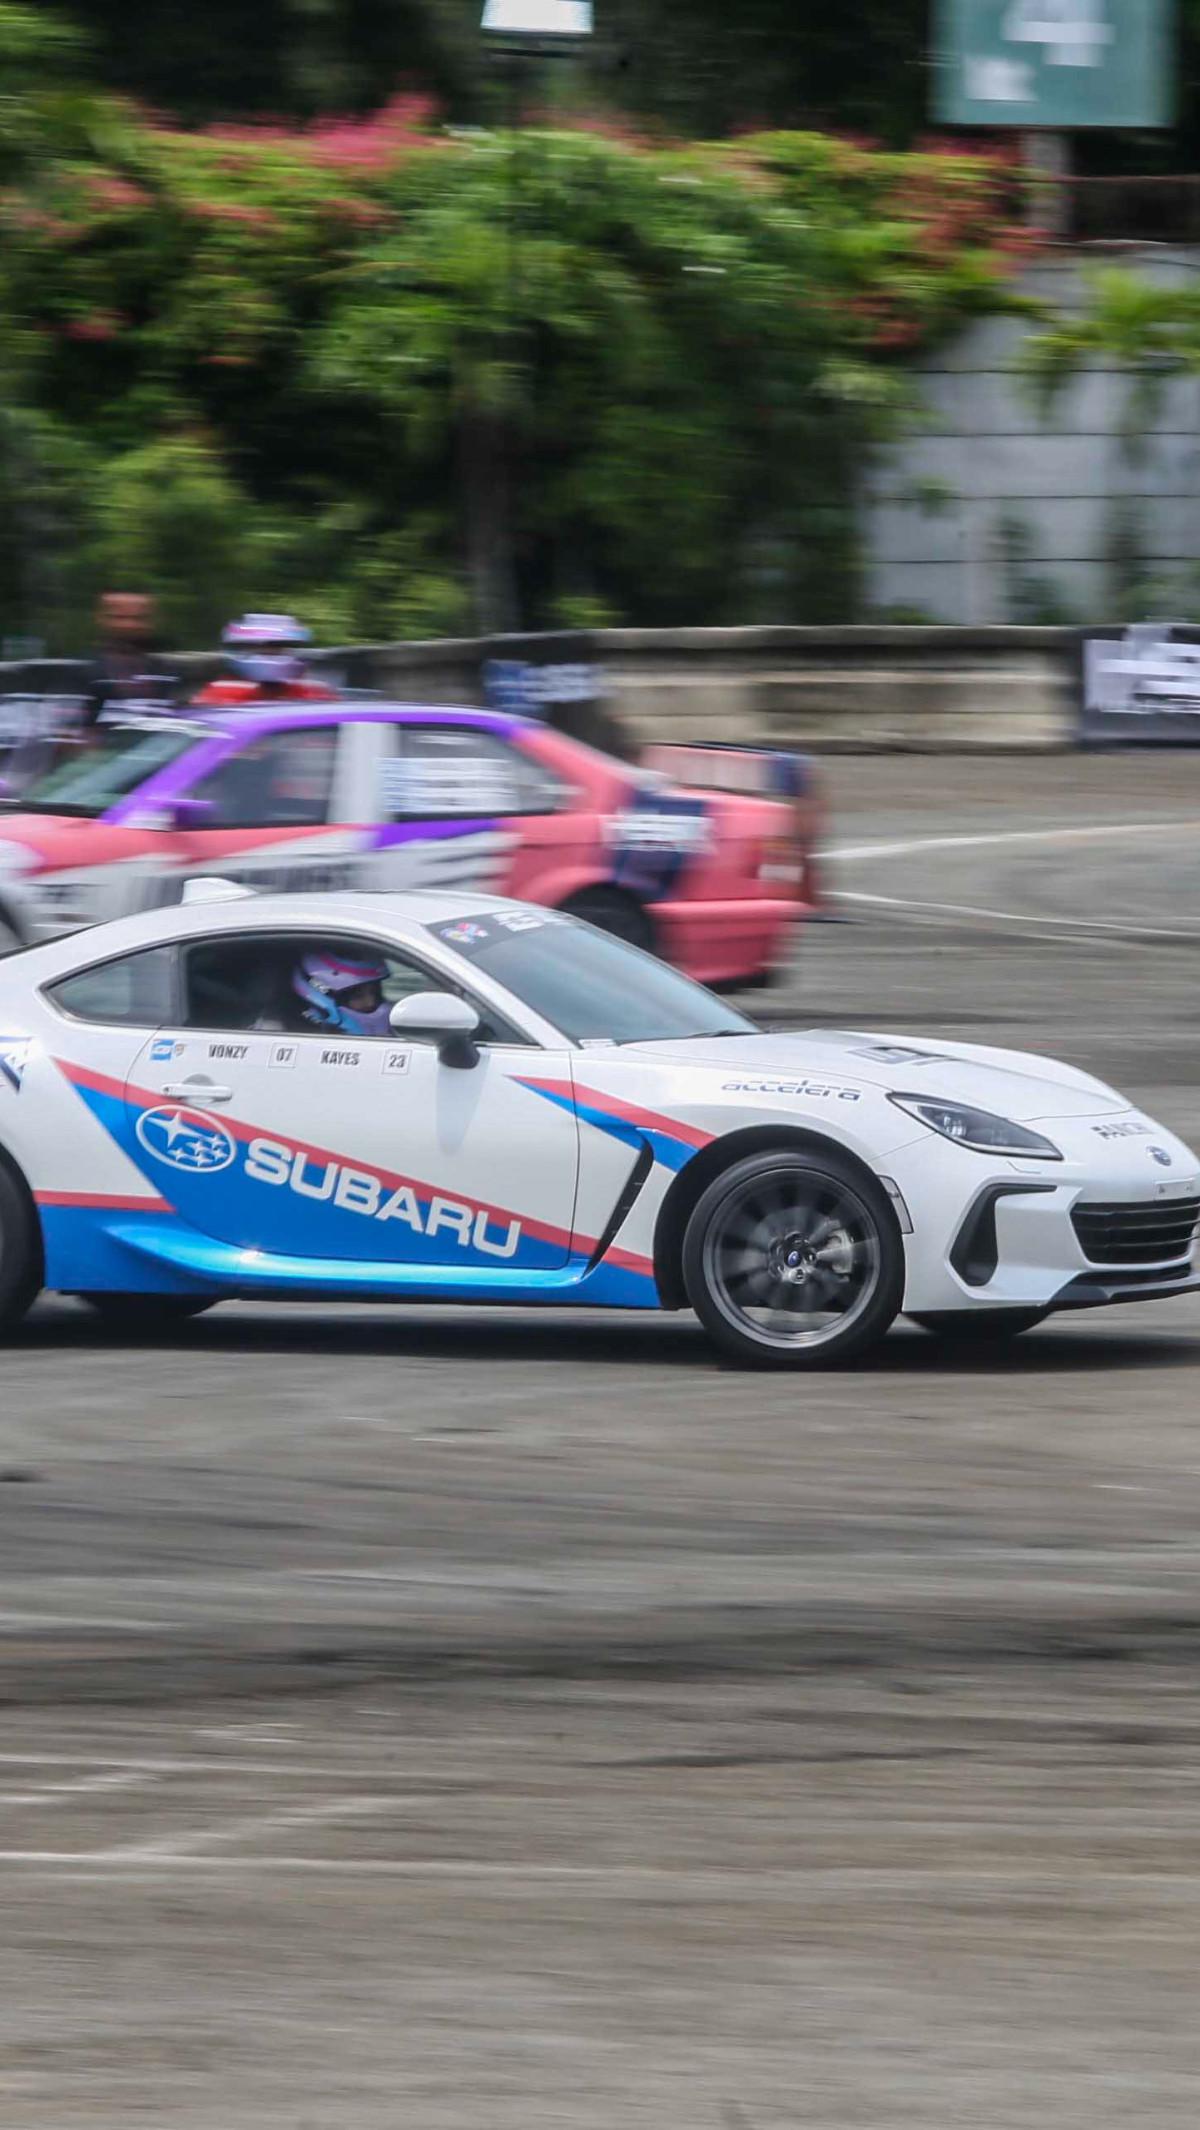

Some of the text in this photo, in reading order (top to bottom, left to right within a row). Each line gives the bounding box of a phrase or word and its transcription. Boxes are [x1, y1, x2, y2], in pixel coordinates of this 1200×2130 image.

[208, 1044, 408, 1068] VONZY 07 KAYES 23
[244, 1138, 521, 1258] SUBARU
